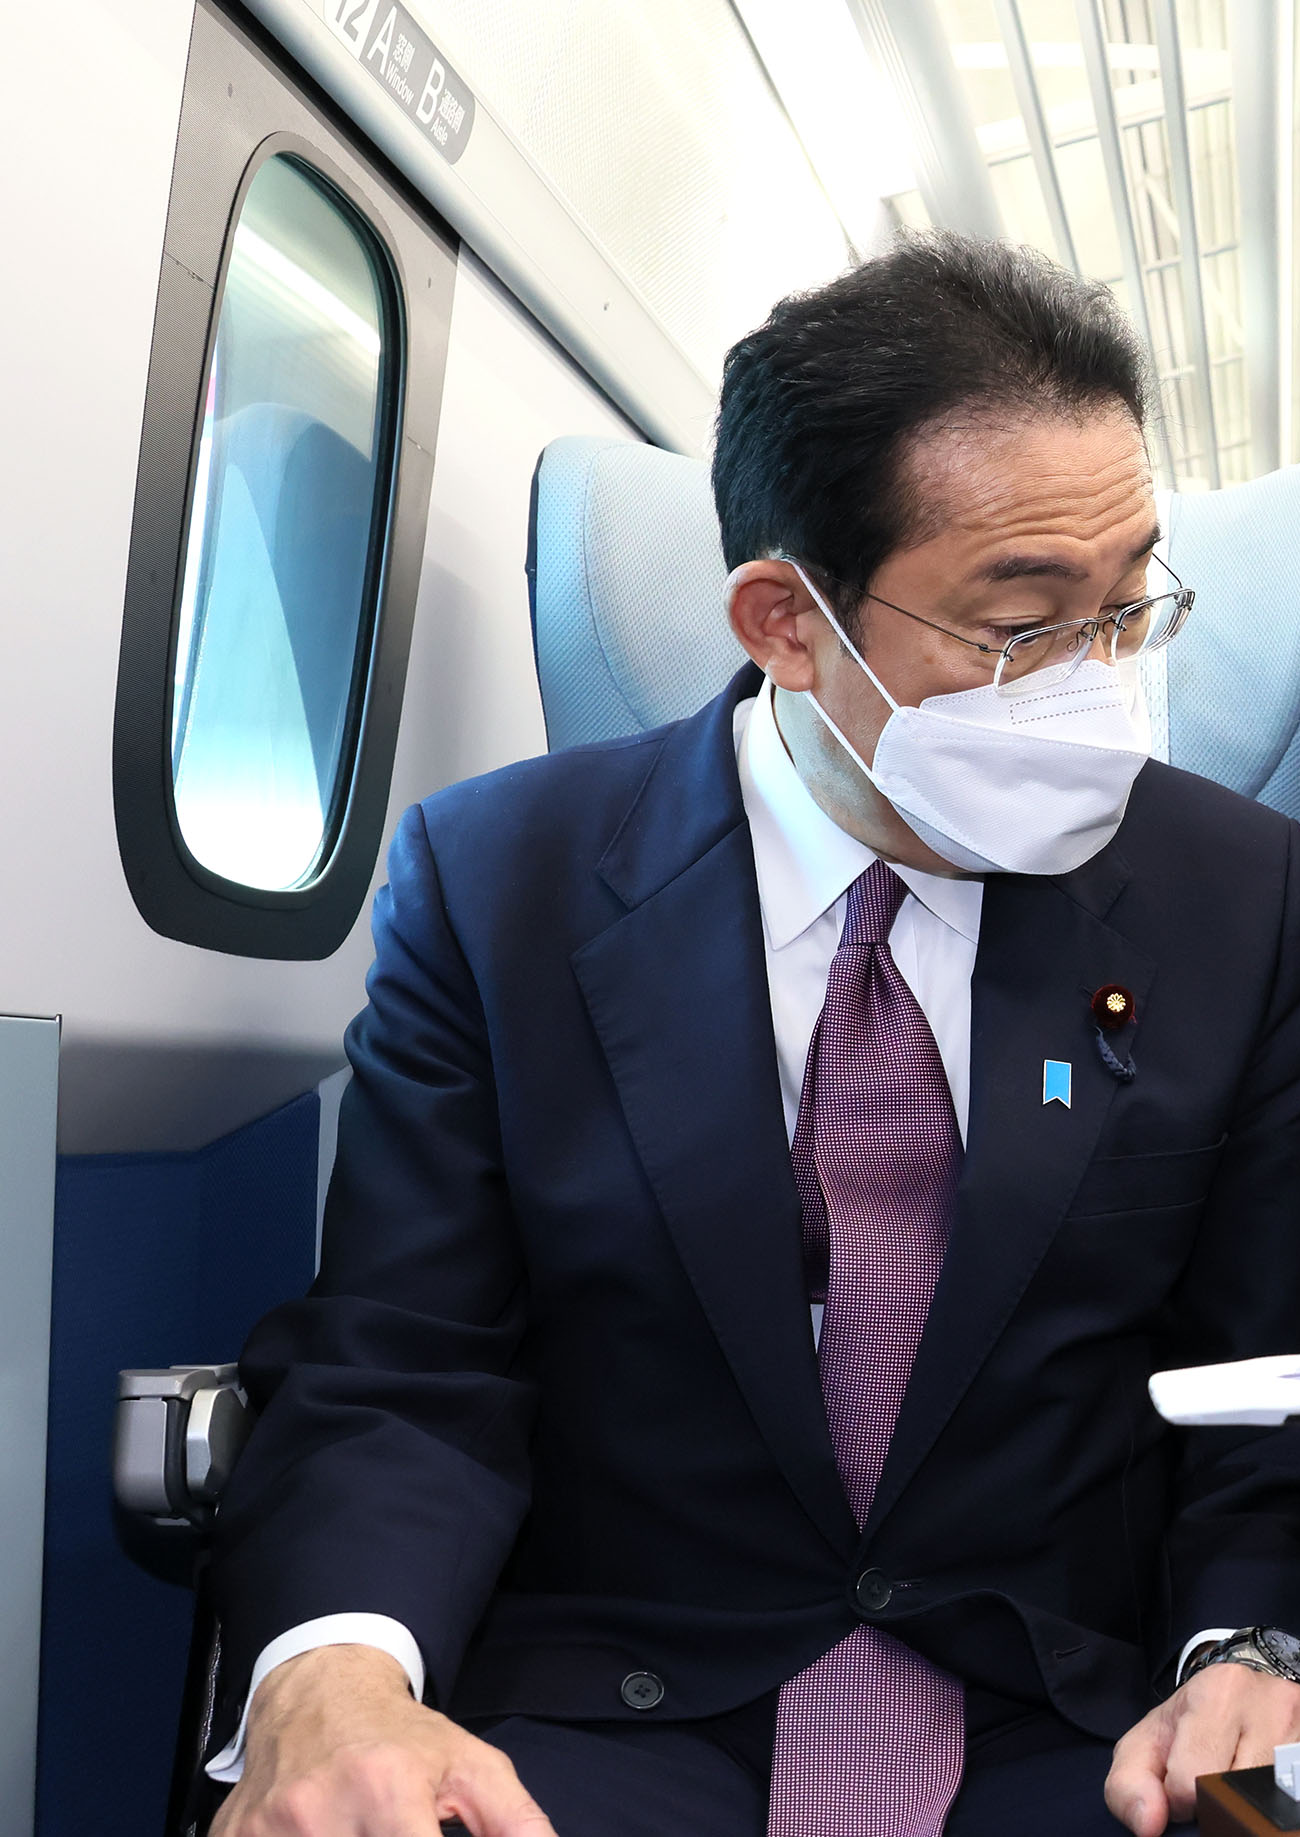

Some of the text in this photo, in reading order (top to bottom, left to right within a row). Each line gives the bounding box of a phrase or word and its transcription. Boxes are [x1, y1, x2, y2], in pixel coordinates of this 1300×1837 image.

[367, 6, 397, 75] A
[393, 33, 415, 73] 窓側
[386, 60, 414, 105] Window
[415, 58, 445, 124] B
[430, 117, 448, 146] Aisle
